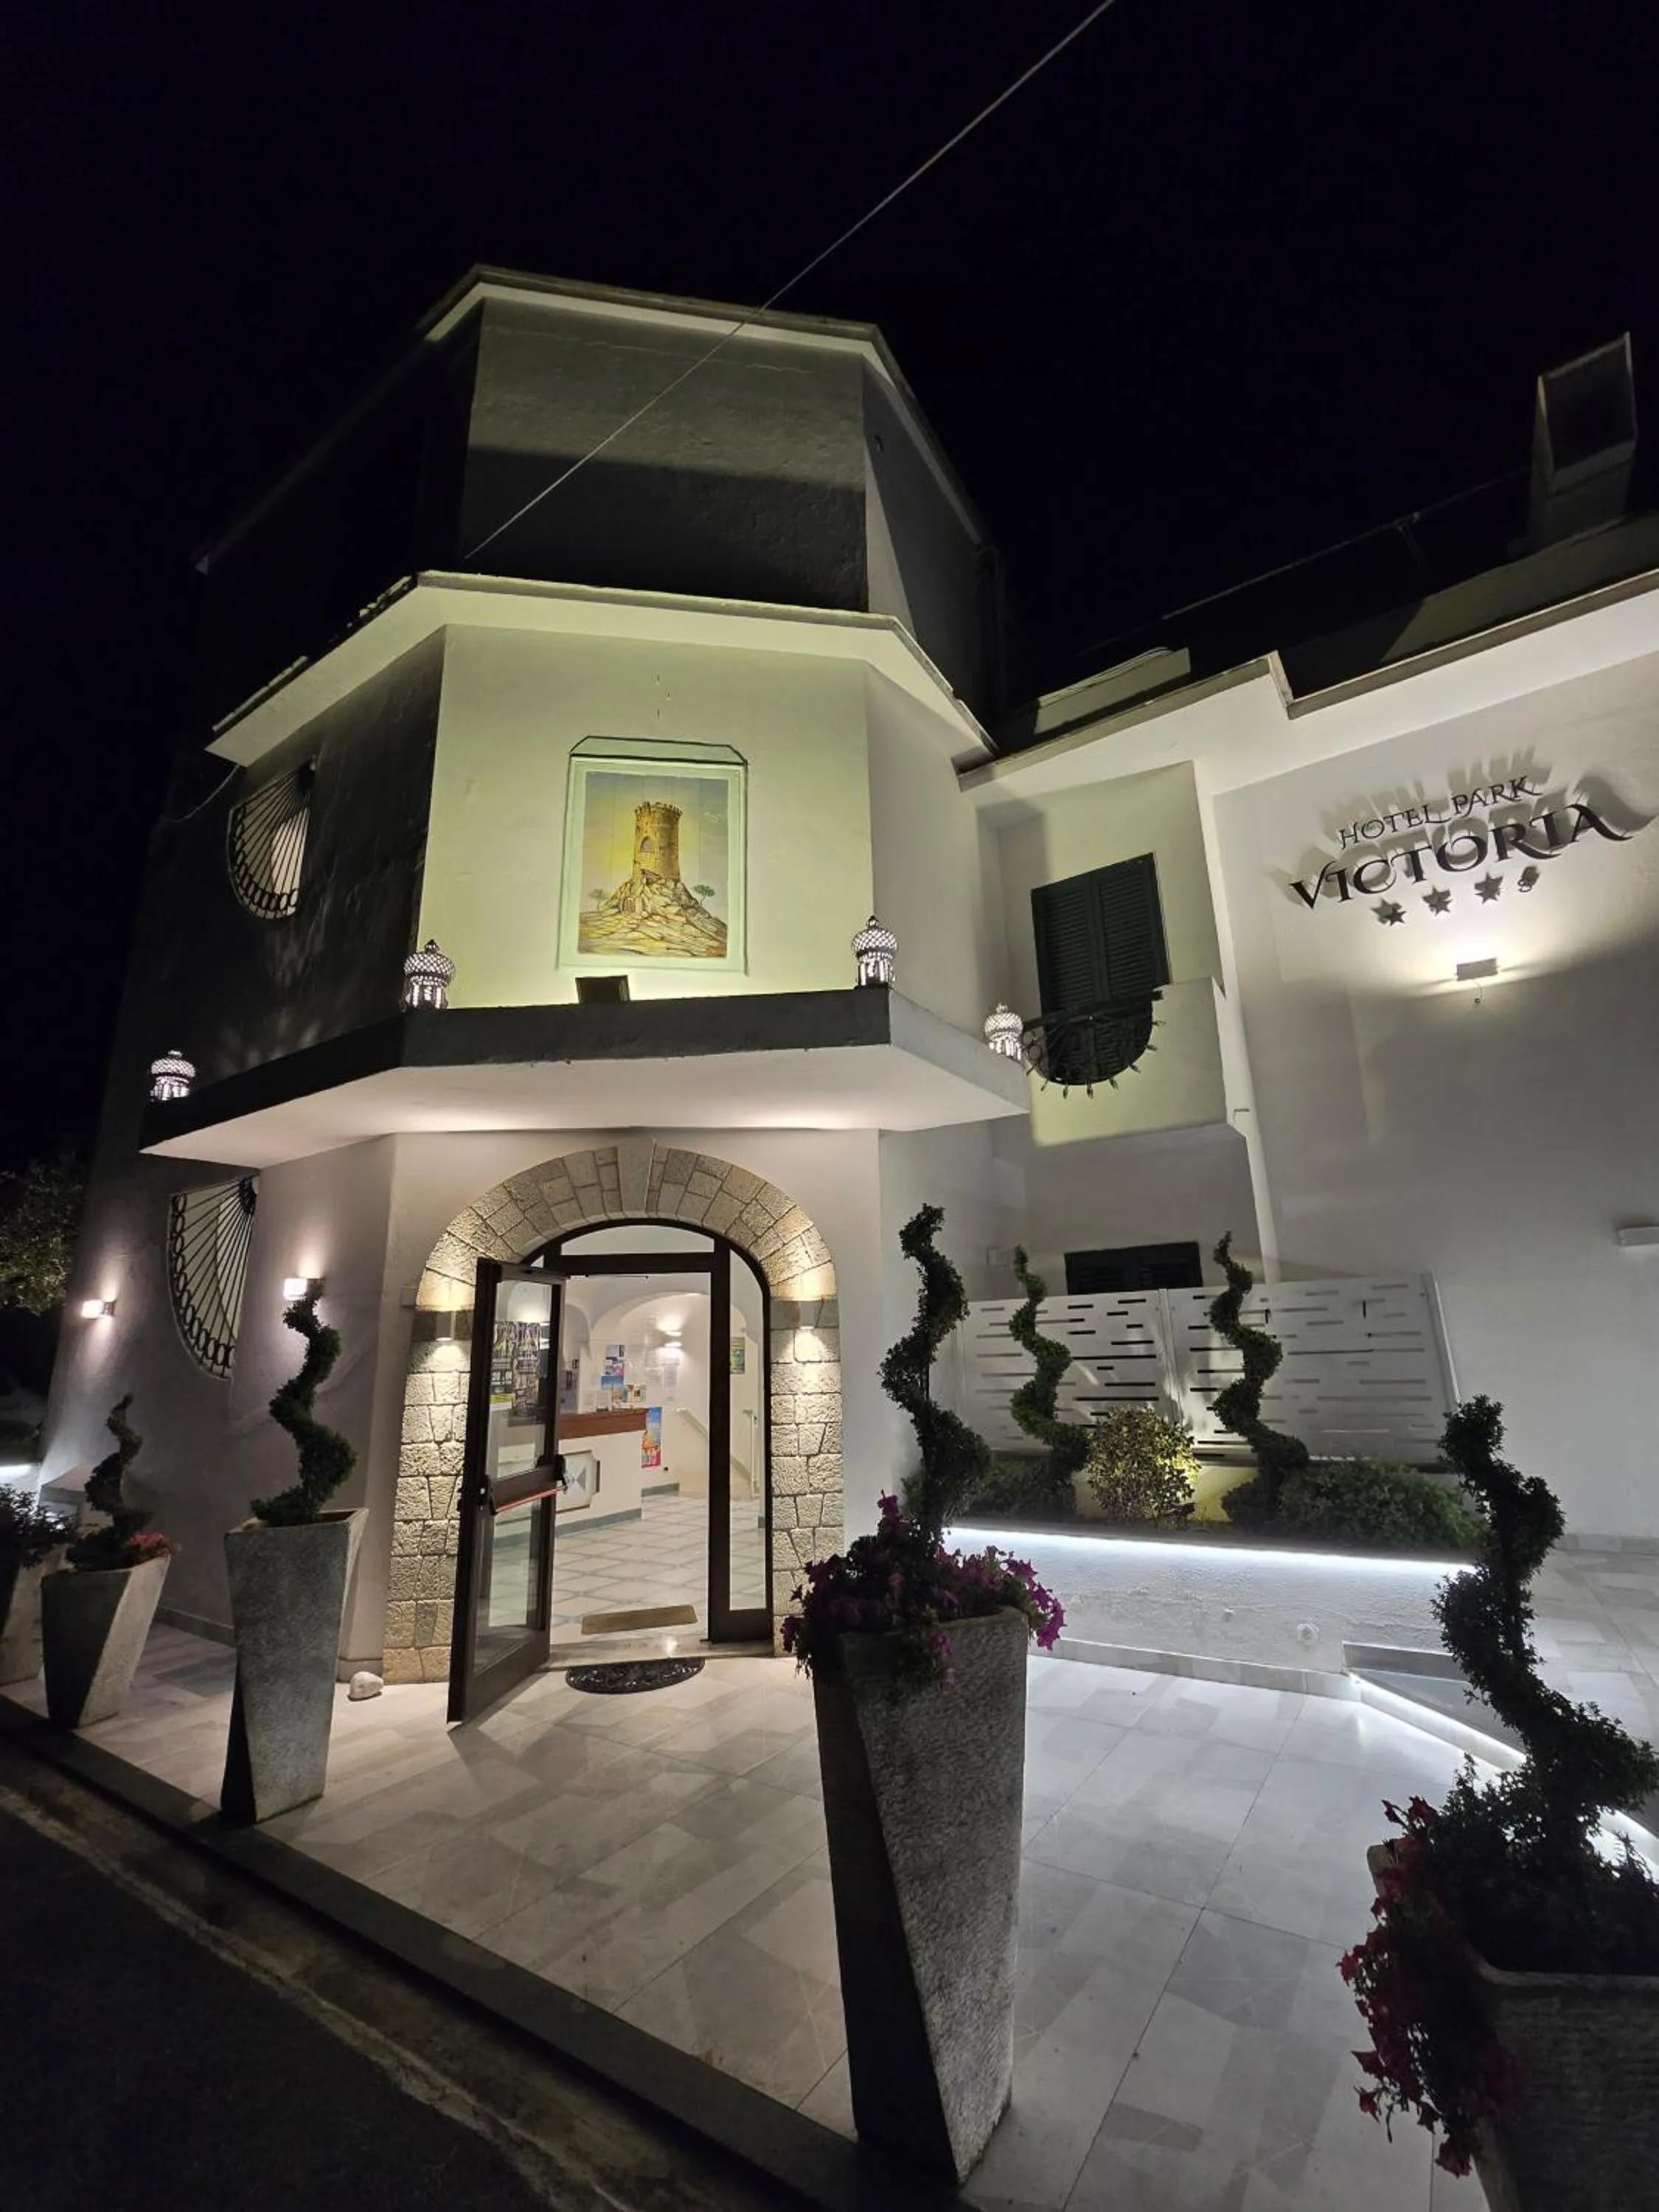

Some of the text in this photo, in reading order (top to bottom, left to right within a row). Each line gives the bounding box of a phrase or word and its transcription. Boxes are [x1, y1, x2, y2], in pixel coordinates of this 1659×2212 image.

[1290, 803, 1633, 910] VICTORIA
[1338, 775, 1542, 849] HOTEL PARK
